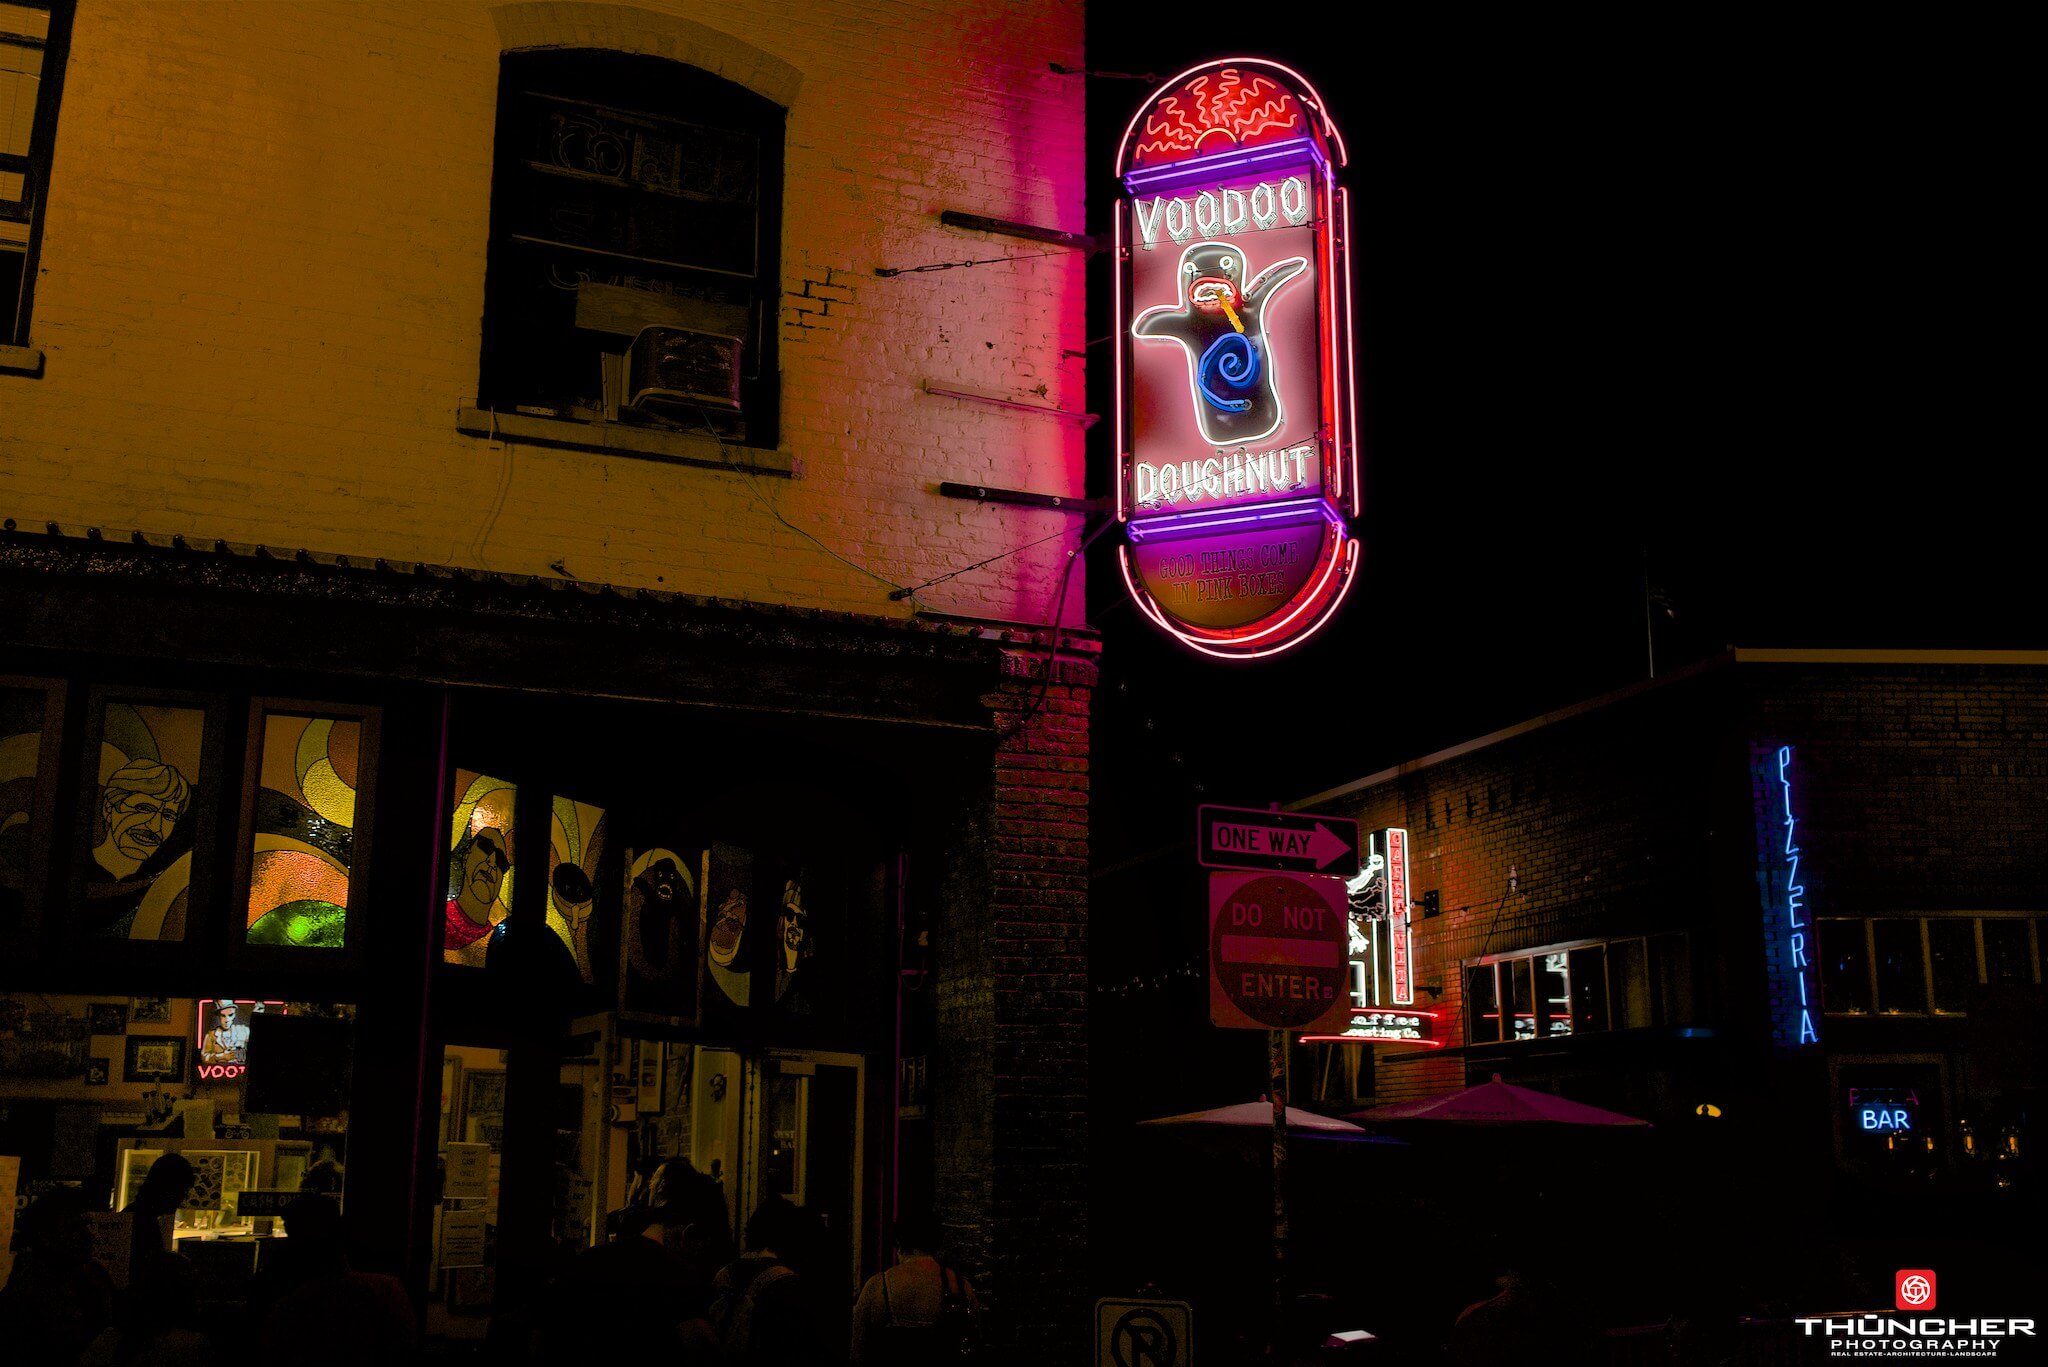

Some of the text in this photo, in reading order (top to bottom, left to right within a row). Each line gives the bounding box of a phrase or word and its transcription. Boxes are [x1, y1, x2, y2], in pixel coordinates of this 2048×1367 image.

[1134, 176, 1307, 250] VOODOO
[1136, 446, 1315, 505] DOUGHNUT
[1159, 541, 1300, 579] GOOD THINGS COME
[1172, 571, 1286, 605] IN PINK BOXES
[1217, 825, 1312, 855] ONE WAY
[1779, 745, 1819, 1045] PIZZERIA
[1231, 902, 1328, 932] DO NOT
[1241, 972, 1321, 1001] ENTER
[1351, 1013, 1420, 1027] offee
[1862, 1109, 1911, 1130] BAR
